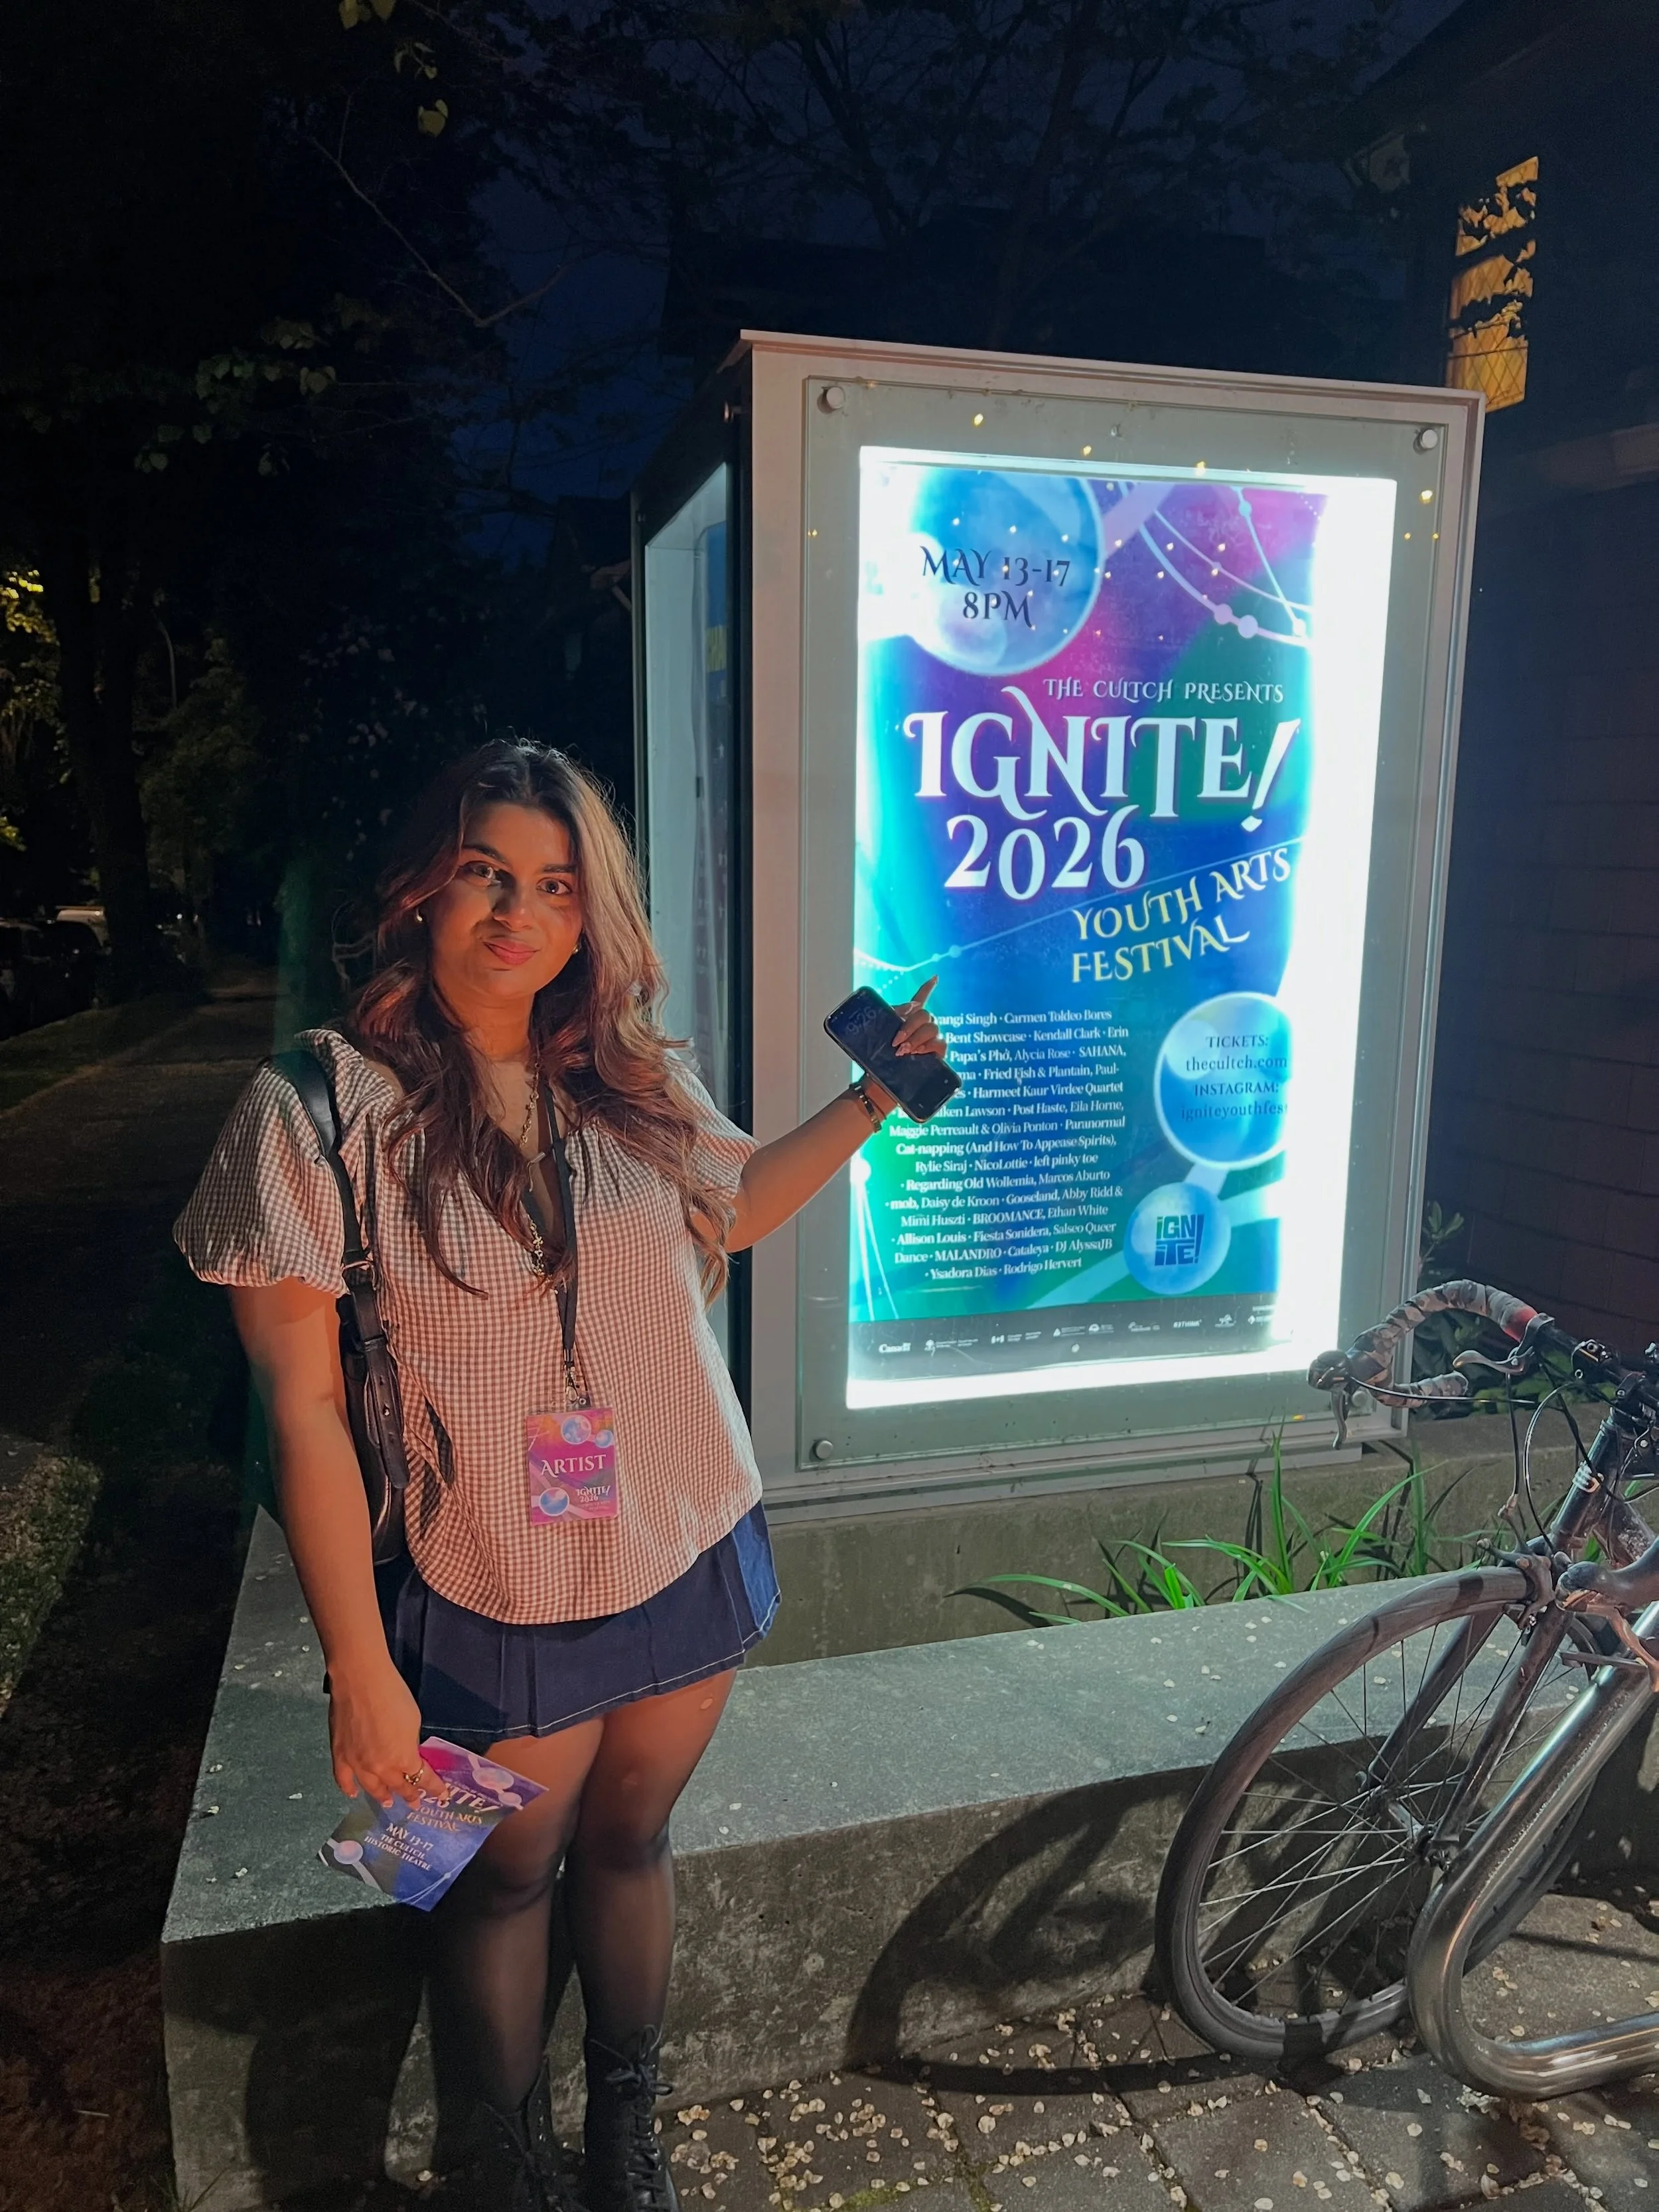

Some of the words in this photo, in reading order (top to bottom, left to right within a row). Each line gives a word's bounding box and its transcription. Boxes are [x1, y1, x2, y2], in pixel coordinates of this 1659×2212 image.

[920, 546, 991, 587] MAY
[1003, 556, 1070, 587] 13-17
[963, 590, 1033, 628] 8PM
[1043, 677, 1083, 700] THE
[1093, 677, 1173, 703] CULTCH
[1185, 681, 1284, 704] PRESENTS
[903, 686, 1301, 832] IGNITE!
[944, 804, 1145, 901] 2026
[1072, 876, 1203, 940] YOUTH
[1209, 848, 1291, 903] ARTS
[1072, 915, 1250, 983] FESTIVAL
[966, 1012, 997, 1027] Singh
[1004, 1012, 1046, 1024] Carmen
[1084, 1009, 1112, 1021] Bores
[946, 1032, 971, 1043] Bent
[974, 1031, 1027, 1043] Showcase
[1034, 1028, 1072, 1041] Kendall
[1074, 1027, 1101, 1039] Clark
[1108, 1025, 1129, 1038] Erin
[1206, 1034, 1269, 1048] TICKETS:
[1014, 1048, 1045, 1063] Alycia
[1048, 1048, 1070, 1059] Rose
[1186, 1055, 1287, 1071] thecultch.com
[983, 1067, 1011, 1080] Fried
[1014, 1067, 1035, 1079] Fish
[1037, 1067, 1046, 1078] &
[1048, 1064, 1093, 1077] Plantain,
[974, 1086, 1021, 1098] Harmeet
[1023, 1085, 1048, 1097] Kaur
[1050, 1082, 1083, 1095] Virdee
[1085, 1081, 1123, 1096] Quartet
[1194, 1082, 1279, 1096] INSTAGRAM:
[965, 1105, 1005, 1117] Lawson
[1013, 1104, 1034, 1116] Post
[889, 1124, 928, 1139] Maggie
[930, 1123, 979, 1136] Perreault
[981, 1123, 989, 1134] &
[992, 1122, 1021, 1134] Olivia
[1065, 1116, 1125, 1130] Paranormal
[966, 1141, 992, 1154] (And
[995, 1140, 1019, 1152] How
[1020, 1140, 1033, 1150] To
[1035, 1138, 1077, 1152] Appease
[915, 1160, 942, 1175] Rylie
[943, 1159, 967, 1174] Siraj
[1052, 1153, 1081, 1169] pinky
[1082, 1153, 1098, 1165] toe
[906, 1178, 963, 1193] Regarding
[964, 1177, 983, 1189] Old
[1039, 1173, 1074, 1185] Marcos
[1075, 1169, 1110, 1181] Aburto
[921, 1197, 950, 1211] Daisy
[952, 1195, 966, 1207] de
[968, 1195, 999, 1207] Kroon
[1062, 1187, 1088, 1202] Abby
[1090, 1186, 1113, 1198] Ridd
[1114, 1185, 1123, 1197] &
[901, 1215, 929, 1227] Mimi
[932, 1213, 966, 1226] Huszti
[1048, 1206, 1076, 1218] Ethan
[1078, 1204, 1108, 1216] White
[897, 1232, 935, 1245] Allison
[936, 1231, 967, 1244] Louis
[974, 1230, 1004, 1242] Fiesta
[1086, 1222, 1116, 1235] Queer
[895, 1252, 928, 1264] Dance
[934, 1248, 1001, 1262] MALANDRO
[1055, 1240, 1067, 1253] DJ
[930, 1266, 973, 1280] Ysadora
[974, 1265, 997, 1278] Dias
[1003, 1262, 1043, 1276] Rodrigo
[1045, 1258, 1082, 1270] Hervert
[540, 1454, 607, 1477] ARTIST
[386, 1822, 410, 1840] MAY
[409, 1835, 435, 1851] 13-17
